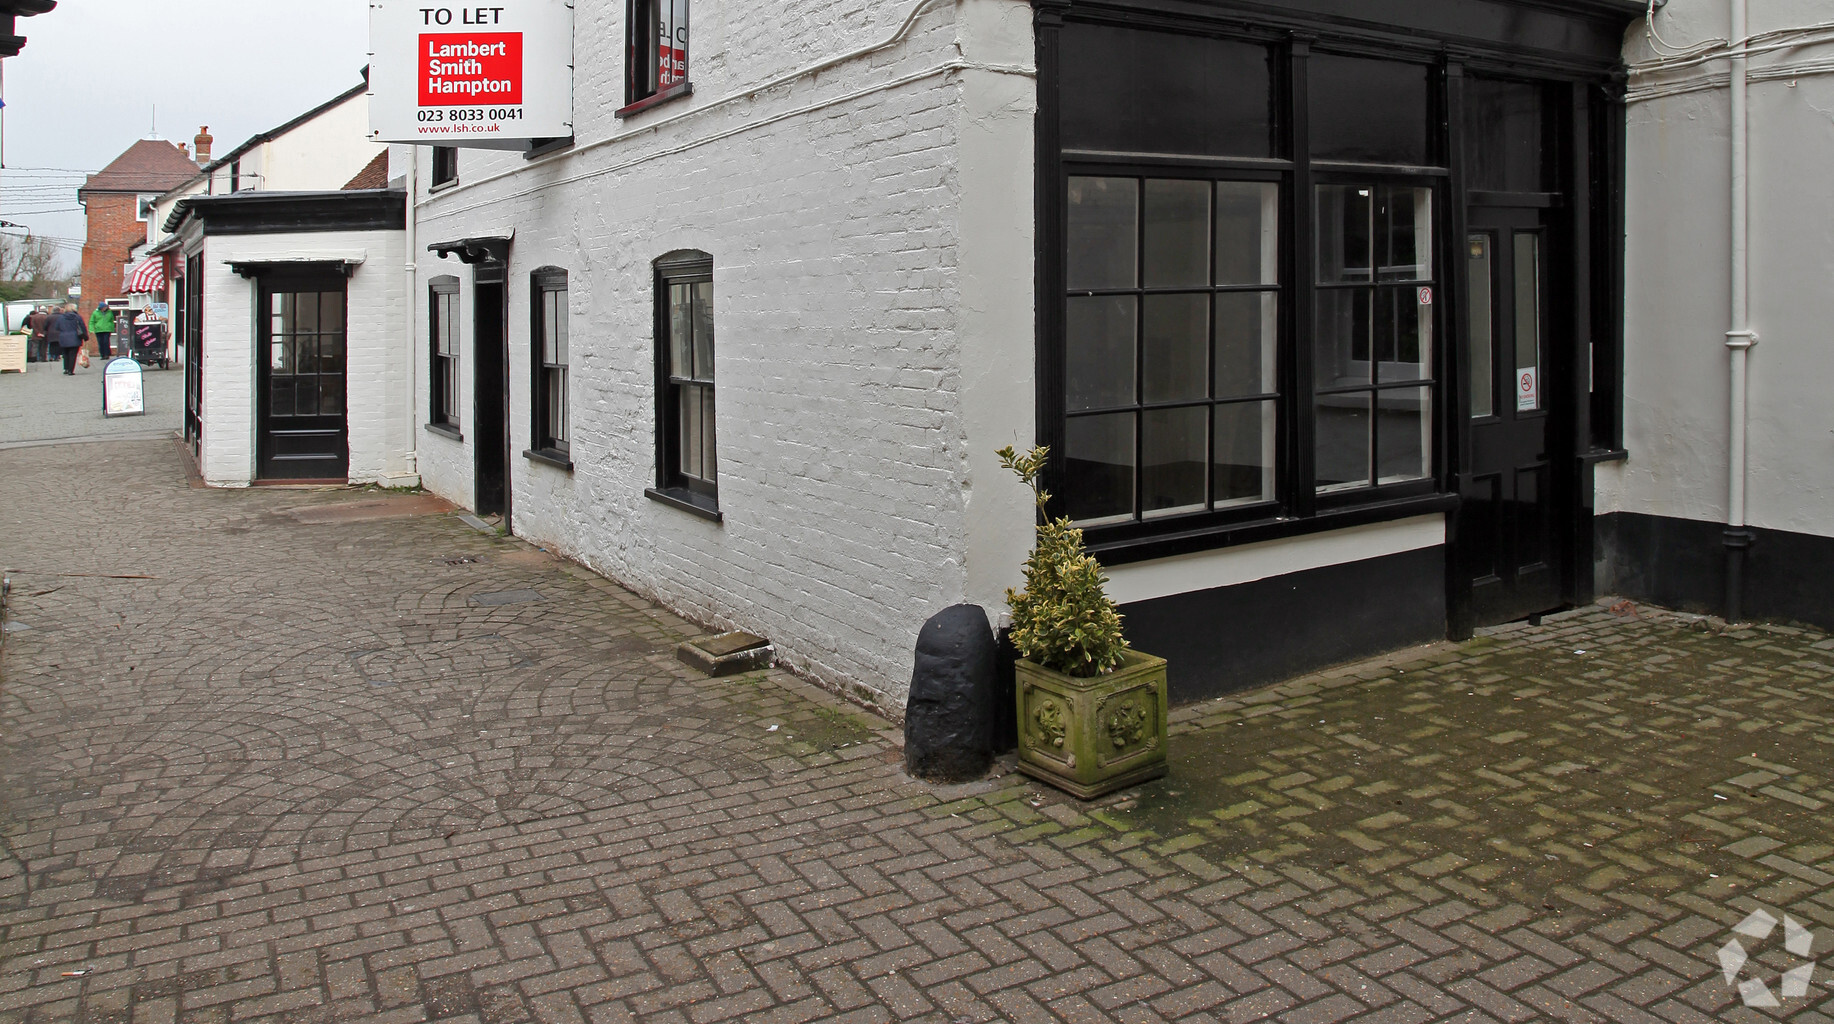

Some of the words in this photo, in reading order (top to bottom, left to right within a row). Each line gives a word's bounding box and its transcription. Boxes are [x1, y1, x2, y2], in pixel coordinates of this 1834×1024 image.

[419, 8, 452, 25] TO
[463, 7, 504, 24] LET
[429, 40, 506, 57] Lambert
[429, 59, 482, 76] Smith
[428, 77, 512, 97] Hampton
[417, 110, 444, 122] 023
[449, 109, 484, 121] 8033
[488, 108, 523, 121] 0041
[417, 123, 501, 134] www.lsh.co.uk
